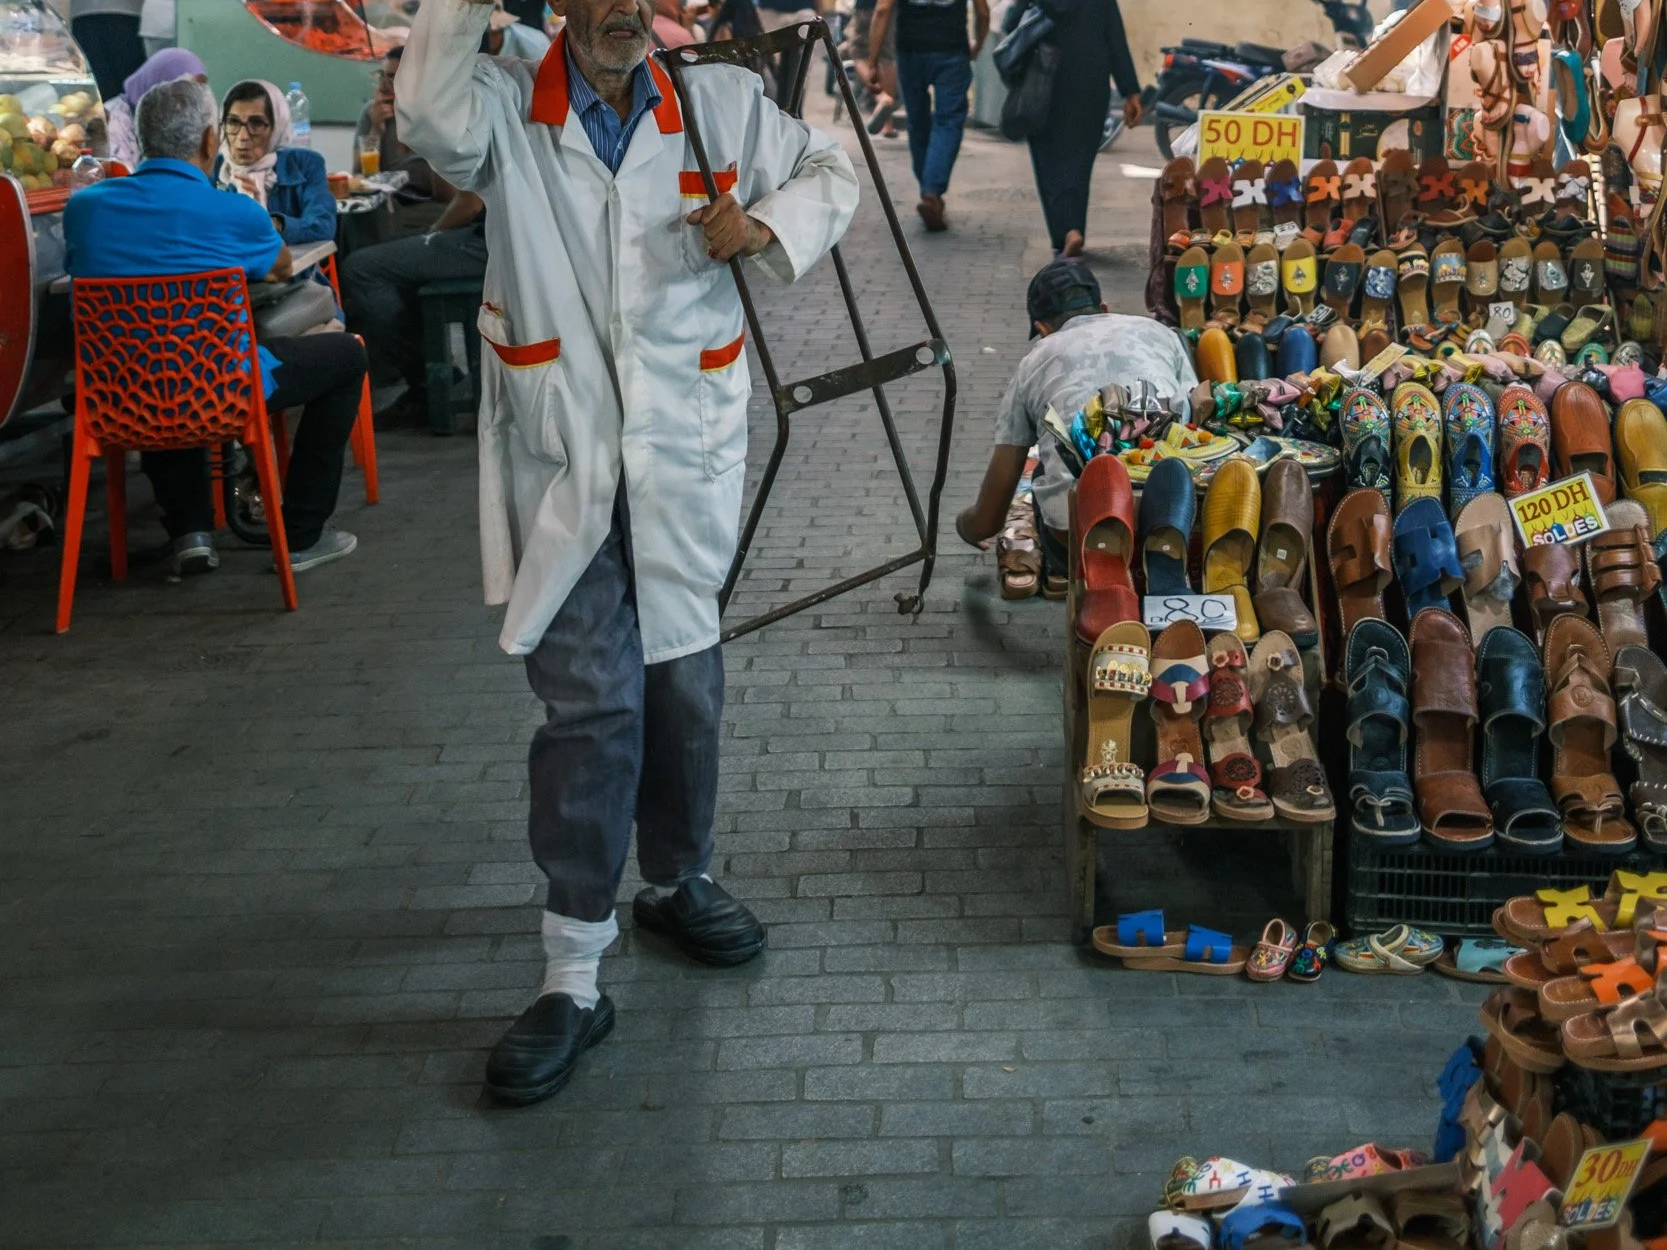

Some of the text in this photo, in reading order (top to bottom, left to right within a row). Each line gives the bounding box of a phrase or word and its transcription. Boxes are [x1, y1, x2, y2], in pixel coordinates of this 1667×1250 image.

[1205, 119, 1241, 145] 50
[1252, 121, 1297, 147] DH
[1493, 306, 1511, 318] 80
[1518, 482, 1589, 523] 120 DH
[1532, 515, 1598, 545] SOLDES
[1163, 597, 1228, 623] 80
[1562, 1200, 1617, 1224] SOLDES
